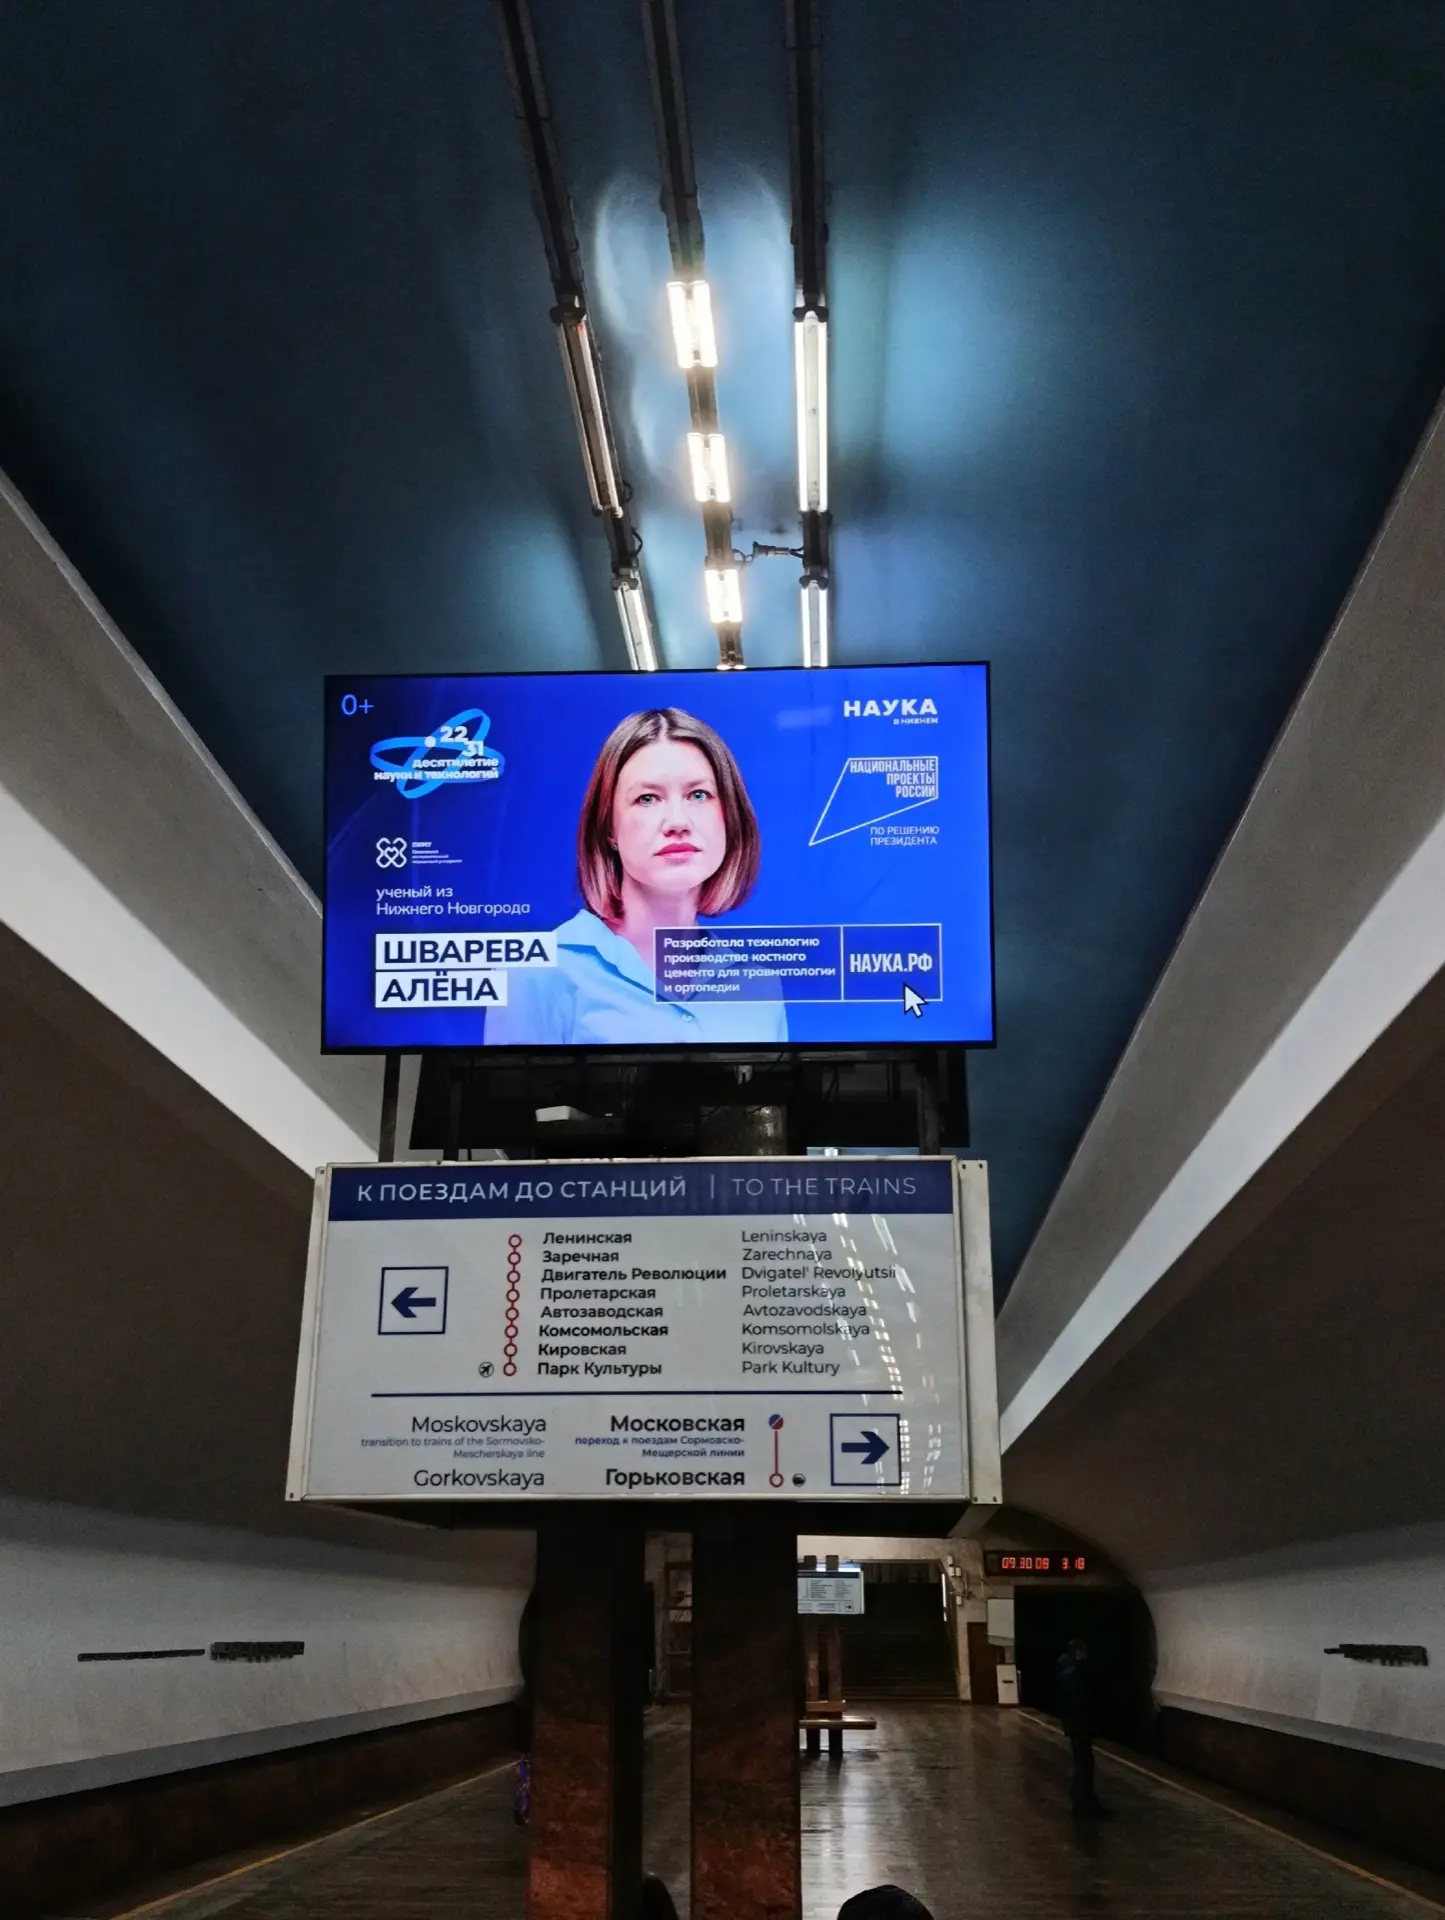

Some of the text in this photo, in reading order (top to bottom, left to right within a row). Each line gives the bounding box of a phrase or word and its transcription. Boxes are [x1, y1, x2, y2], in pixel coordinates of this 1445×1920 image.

[341, 694, 374, 716] 0+
[844, 698, 938, 718] НАУКА
[901, 717, 938, 725] НИЖНЕМ
[440, 726, 468, 743] 22
[462, 740, 484, 757] 31
[413, 758, 499, 769] десятилетие
[850, 759, 936, 774] НАЦИОНАЛЬНЫЕ
[374, 772, 412, 783] науки
[425, 769, 499, 780] технологий
[886, 772, 936, 786] ПРОЕКТЫ
[895, 785, 936, 798] РОССИИ
[870, 825, 940, 835] ПО РЕШЕНИЮ
[870, 836, 938, 846] ПРЕЗИДЕНТА
[376, 886, 453, 901] ученый из
[376, 901, 530, 917] Нижнего Новгорода
[664, 936, 820, 951] Разработала технологию
[383, 939, 550, 964] ШВАРЕВА
[664, 952, 806, 965] производства костного
[849, 952, 933, 973] НАУКА.РФ
[664, 966, 836, 979] цемента для травматологии
[382, 970, 499, 1002] АЛЁНА
[664, 982, 740, 995] и ортопедии
[357, 1176, 686, 1203] К ПОЕЗДАМ ДО СТАНЦИЙ
[732, 1177, 917, 1196] TO THE TRAINS
[543, 1232, 633, 1245] Ленинская
[741, 1230, 827, 1244] Leninskaya
[542, 1250, 620, 1264] Заречная
[742, 1248, 832, 1262] Zarechnaya
[541, 1268, 727, 1283] Двигатель Революции
[741, 1266, 810, 1282] Dvigatel'
[540, 1287, 656, 1302] Пролетарская
[741, 1285, 846, 1300] Proletarskaya
[541, 1305, 664, 1321] Автозаводская
[743, 1304, 867, 1319] Avtozavodskaya
[539, 1325, 669, 1337] Комсомольская
[741, 1322, 870, 1337] Komsomolskaya
[538, 1343, 627, 1357] Кировская
[741, 1342, 824, 1356] Kirovskaya
[538, 1361, 662, 1377] Парк Культуры
[741, 1360, 840, 1376] Park Kultury
[412, 1415, 546, 1436] Moskovskaya
[611, 1415, 745, 1433] Московская
[361, 1436, 545, 1447] transition to trains of the Sormovsko-
[575, 1437, 620, 1446] переход
[631, 1437, 678, 1445] поездам
[680, 1435, 744, 1445] Сормовско-
[453, 1449, 545, 1460] Mescherskaya line
[642, 1448, 745, 1458] Мещерской линии
[414, 1468, 545, 1490] Gorkovskaya
[606, 1468, 745, 1489] Горьковская
